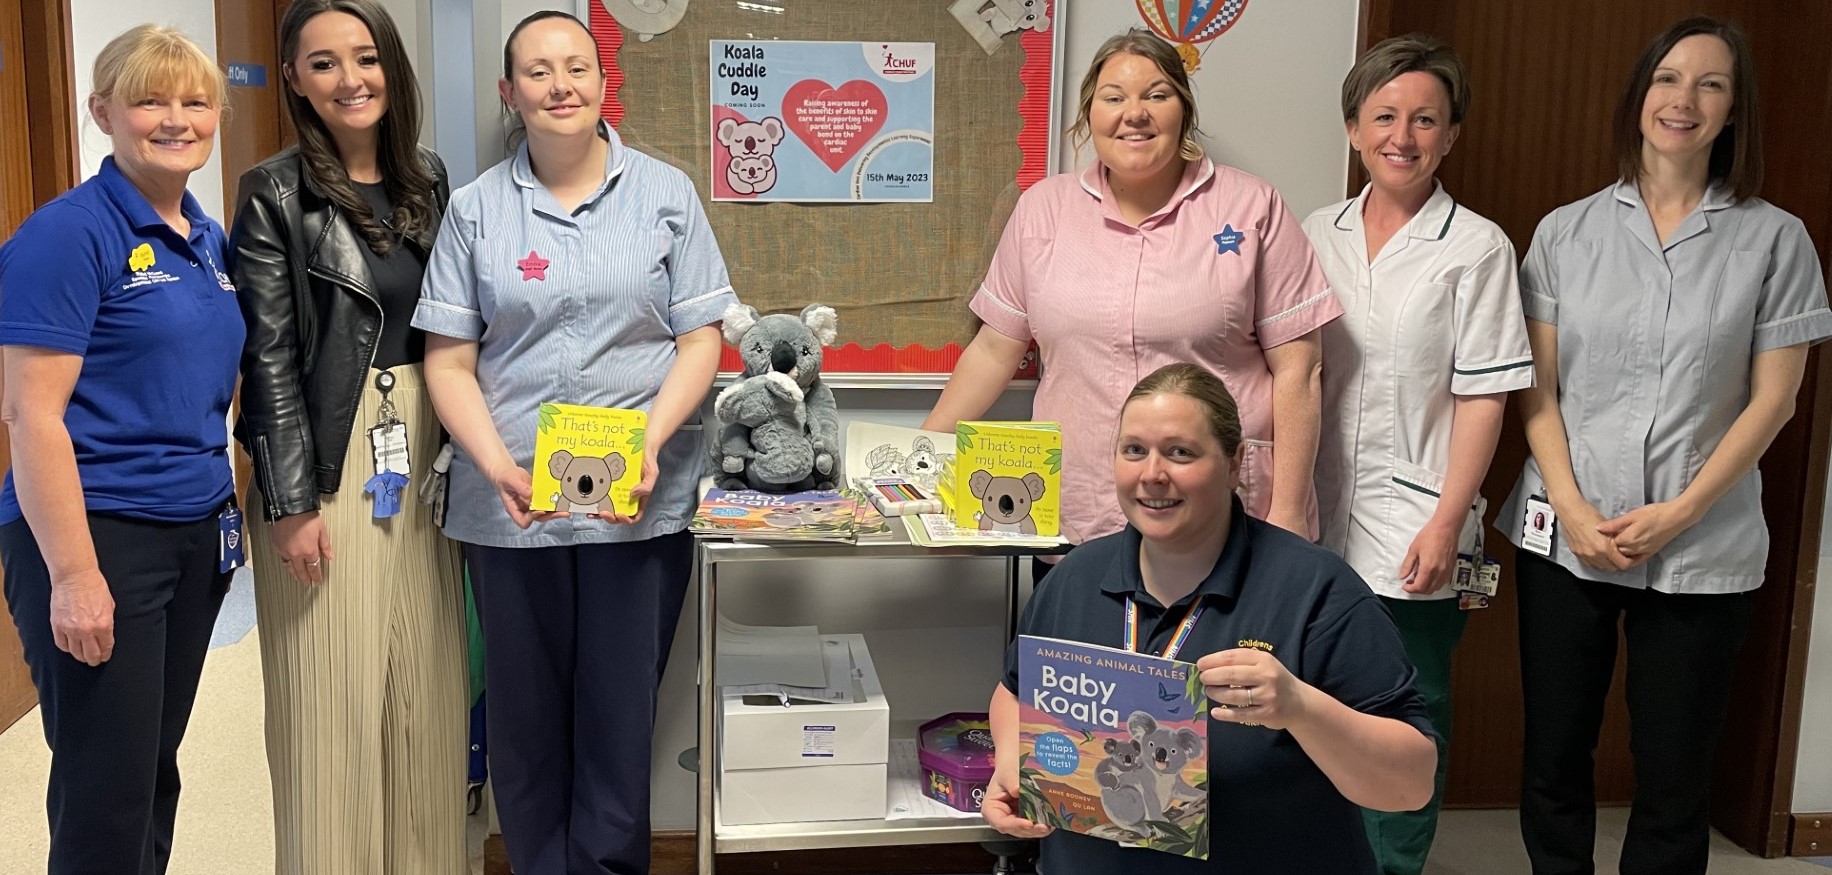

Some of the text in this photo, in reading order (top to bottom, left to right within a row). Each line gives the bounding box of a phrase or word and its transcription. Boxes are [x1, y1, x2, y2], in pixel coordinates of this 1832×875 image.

[724, 44, 764, 60] Koala
[718, 62, 766, 78] Cuddle
[892, 59, 916, 68] CHUF
[235, 67, 248, 84] Only
[731, 81, 758, 101] Day
[803, 99, 825, 108] Raising
[827, 116, 861, 124] supporting
[810, 124, 831, 132] parent
[845, 124, 862, 132] baby
[867, 173, 928, 184] 15th May 2023
[561, 417, 624, 434] That's not
[557, 433, 625, 449] my koala...
[978, 437, 1041, 455] That's not
[976, 454, 1043, 470] my koala...
[715, 497, 786, 506] Koala
[725, 493, 785, 502] Baby
[1238, 639, 1274, 651] Childrens
[1037, 647, 1185, 680] AMAZING ANIMAL TALES
[1042, 665, 1116, 705] Baby
[1033, 689, 1119, 728] Koala
[1046, 736, 1064, 744] Open
[1052, 744, 1073, 754] flaps
[1047, 758, 1071, 768] facts!
[1048, 789, 1091, 802] ANNE ROONEY
